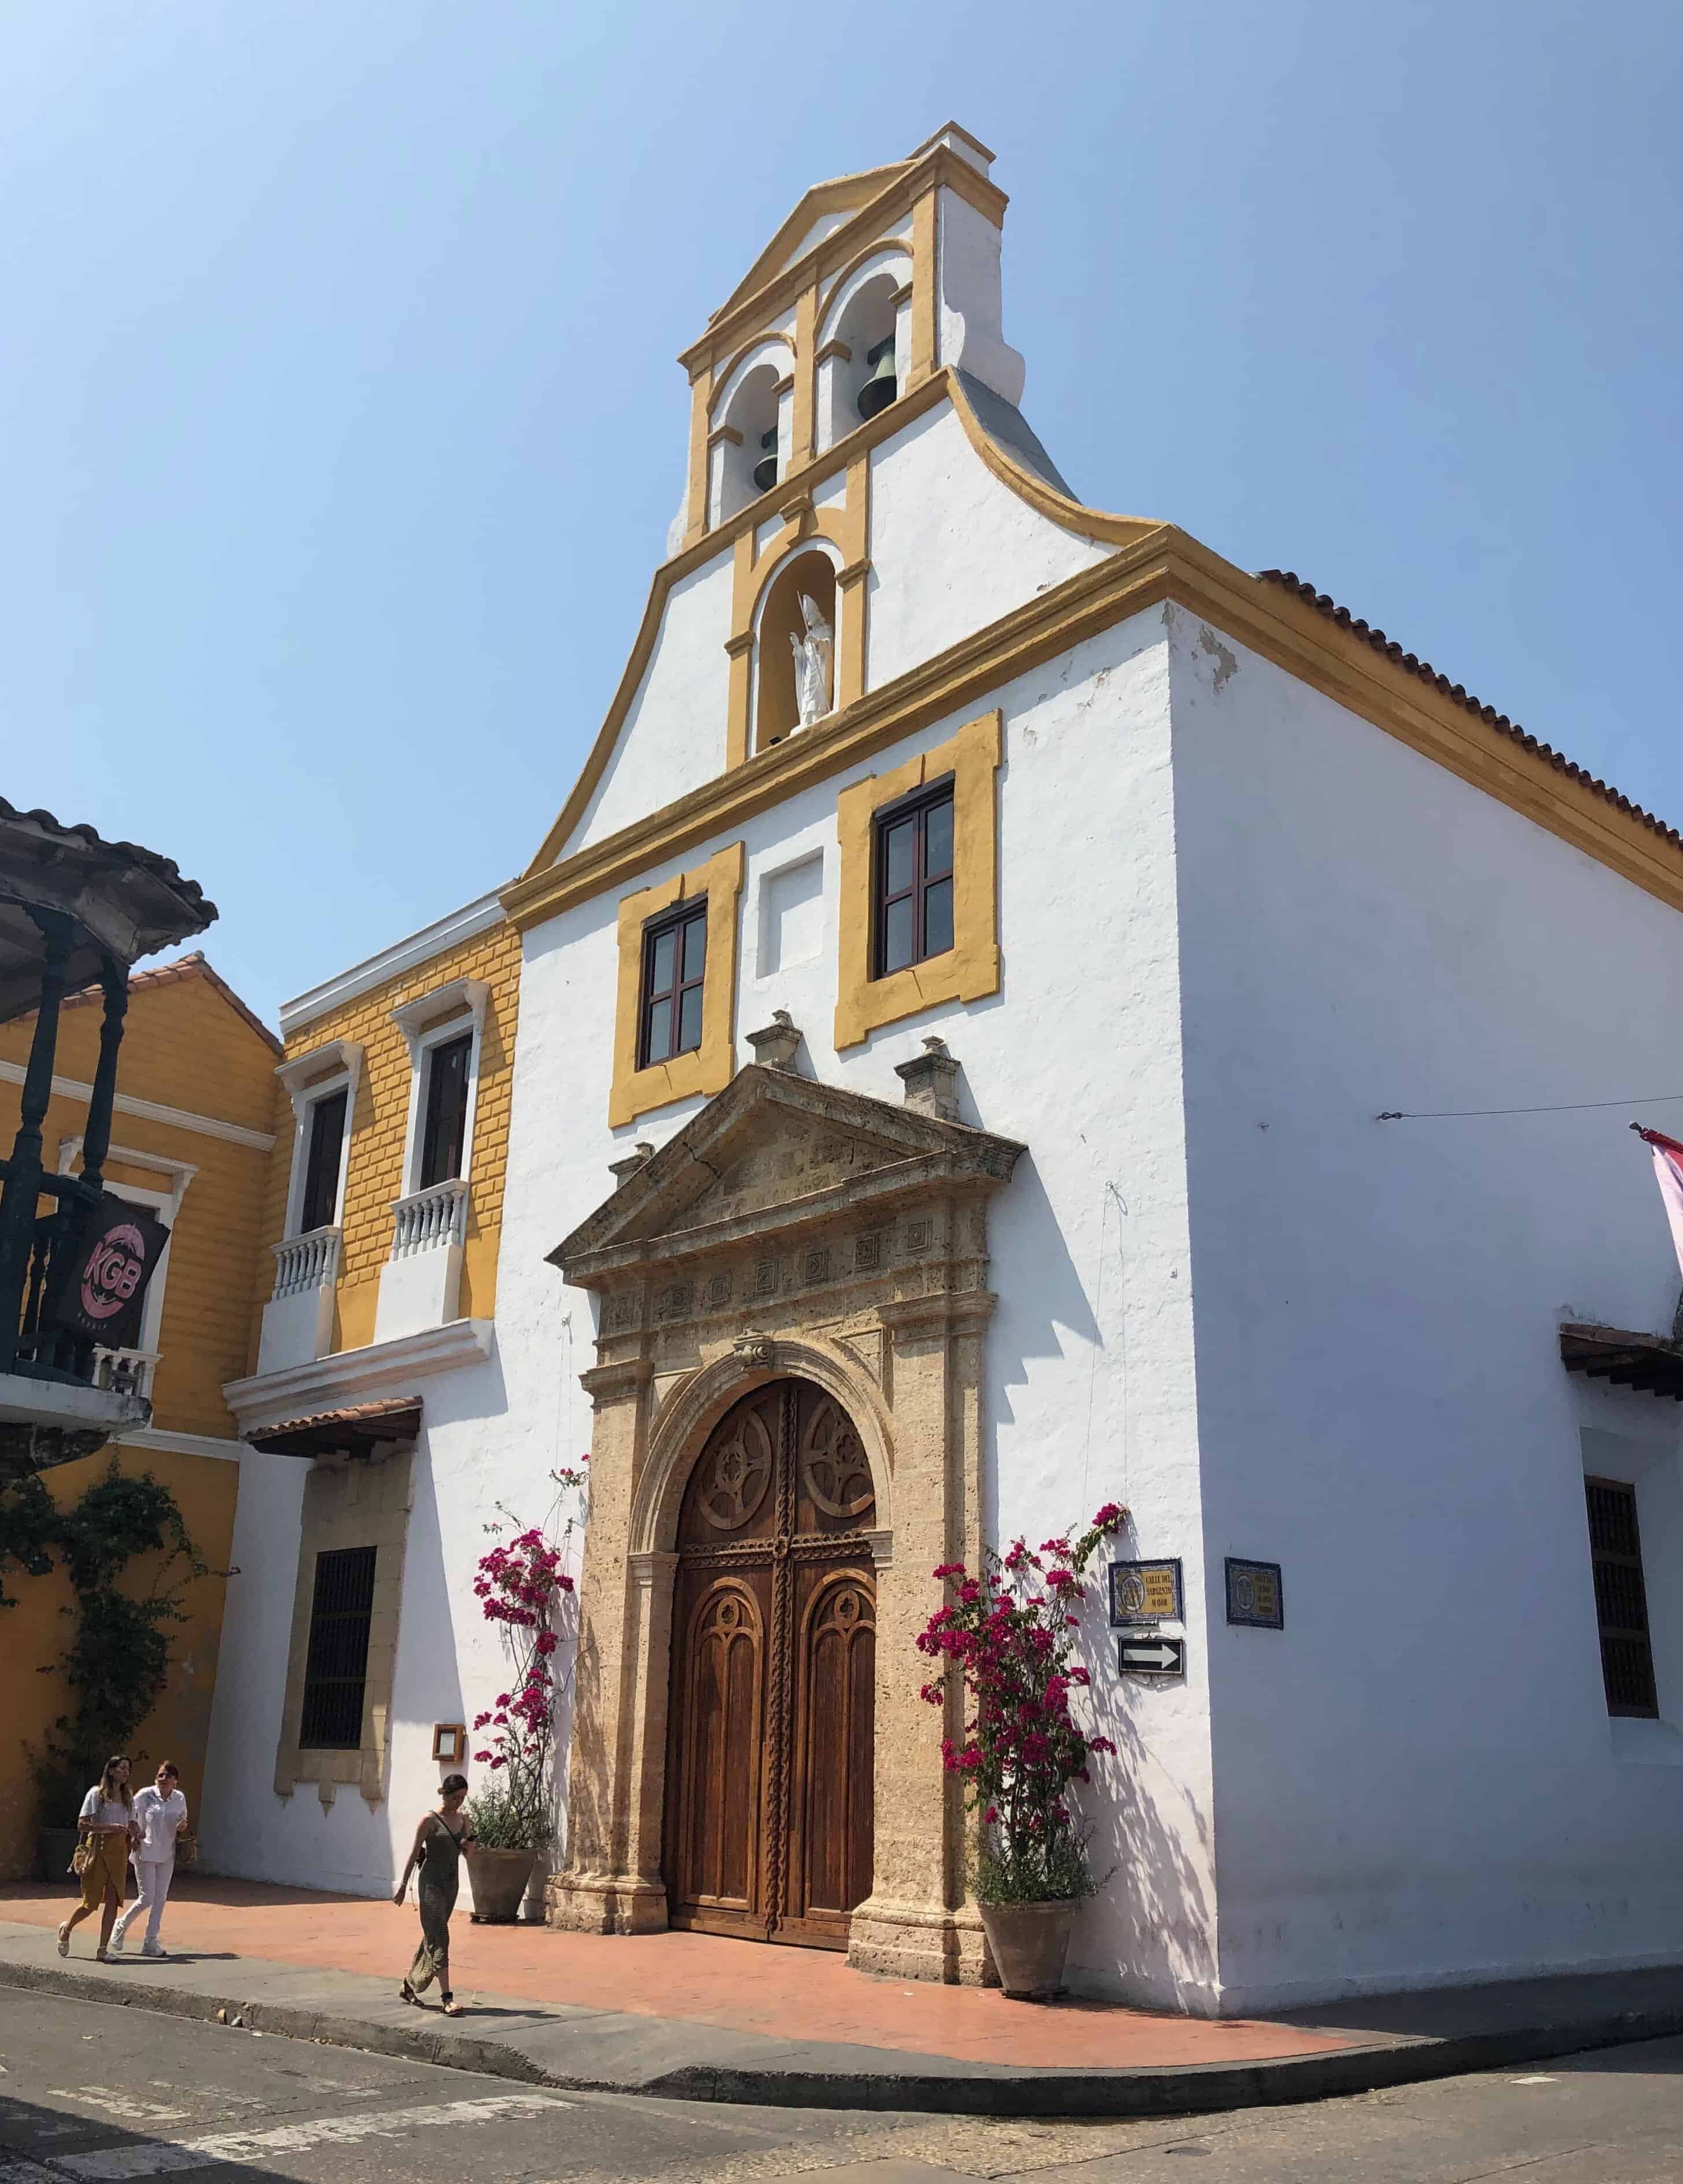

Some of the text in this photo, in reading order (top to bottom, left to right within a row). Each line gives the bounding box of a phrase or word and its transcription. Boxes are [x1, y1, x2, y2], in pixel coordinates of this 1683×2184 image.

[83, 1242, 142, 1299] KGB
[1146, 1574, 1171, 1584] CALLE DEL
[1147, 1587, 1172, 1596] SARGENTO
[1151, 1599, 1168, 1607] MAYOR
